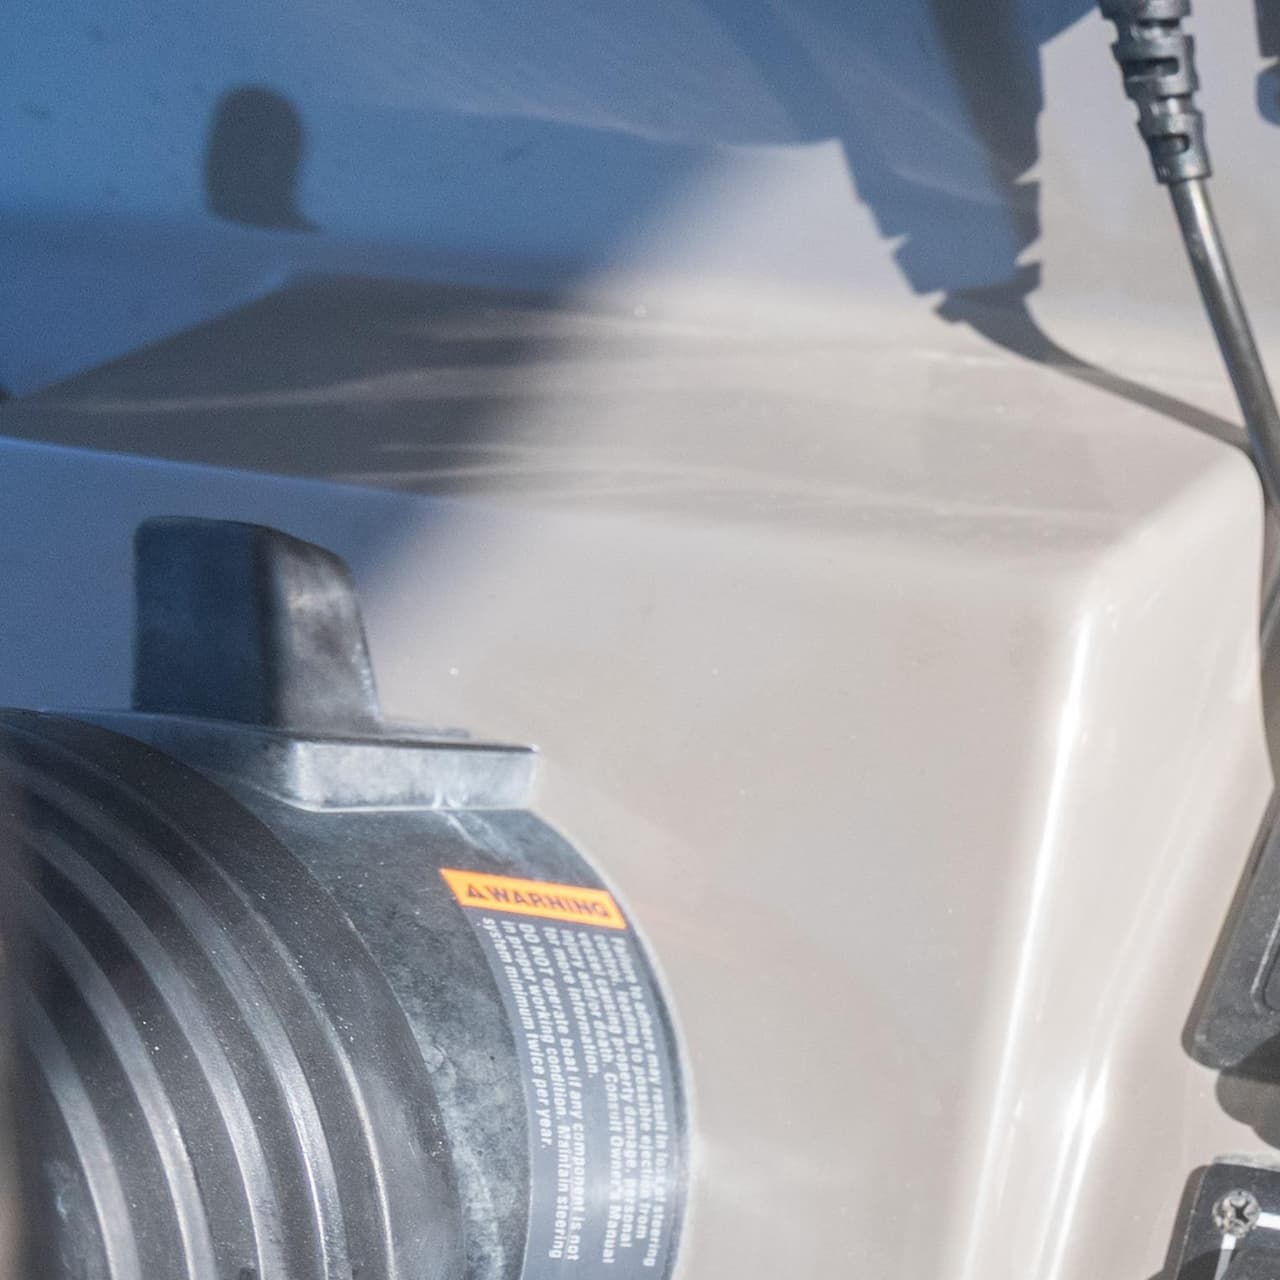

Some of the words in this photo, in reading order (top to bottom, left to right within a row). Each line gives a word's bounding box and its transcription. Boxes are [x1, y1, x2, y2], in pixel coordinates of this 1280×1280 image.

[486, 884, 612, 918] WARNING
[481, 917, 512, 964] system
[518, 923, 541, 944] DO
[543, 926, 561, 947] for
[552, 947, 576, 985] more
[504, 934, 538, 981] proper
[529, 946, 554, 977] NOT
[504, 965, 535, 1030] minimum
[528, 984, 555, 1044] working
[542, 978, 569, 1035] operate
[525, 1032, 546, 1075] twice
[559, 1037, 579, 1073] boat
[596, 978, 622, 1034] causing
[611, 1037, 634, 1104] property
[531, 1078, 550, 1107] per
[545, 1047, 568, 1121] condition.
[569, 1090, 584, 1120] any
[603, 1072, 623, 1132] Consult
[535, 1109, 552, 1149] year.
[652, 1087, 668, 1131] result
[556, 1124, 572, 1193] Maintain
[571, 1122, 585, 1213] component
[548, 1195, 569, 1258] steering
[602, 1205, 622, 1264] Manual
[635, 1202, 651, 1239] from
[643, 1205, 665, 1267] steering
[567, 1234, 581, 1261] not
